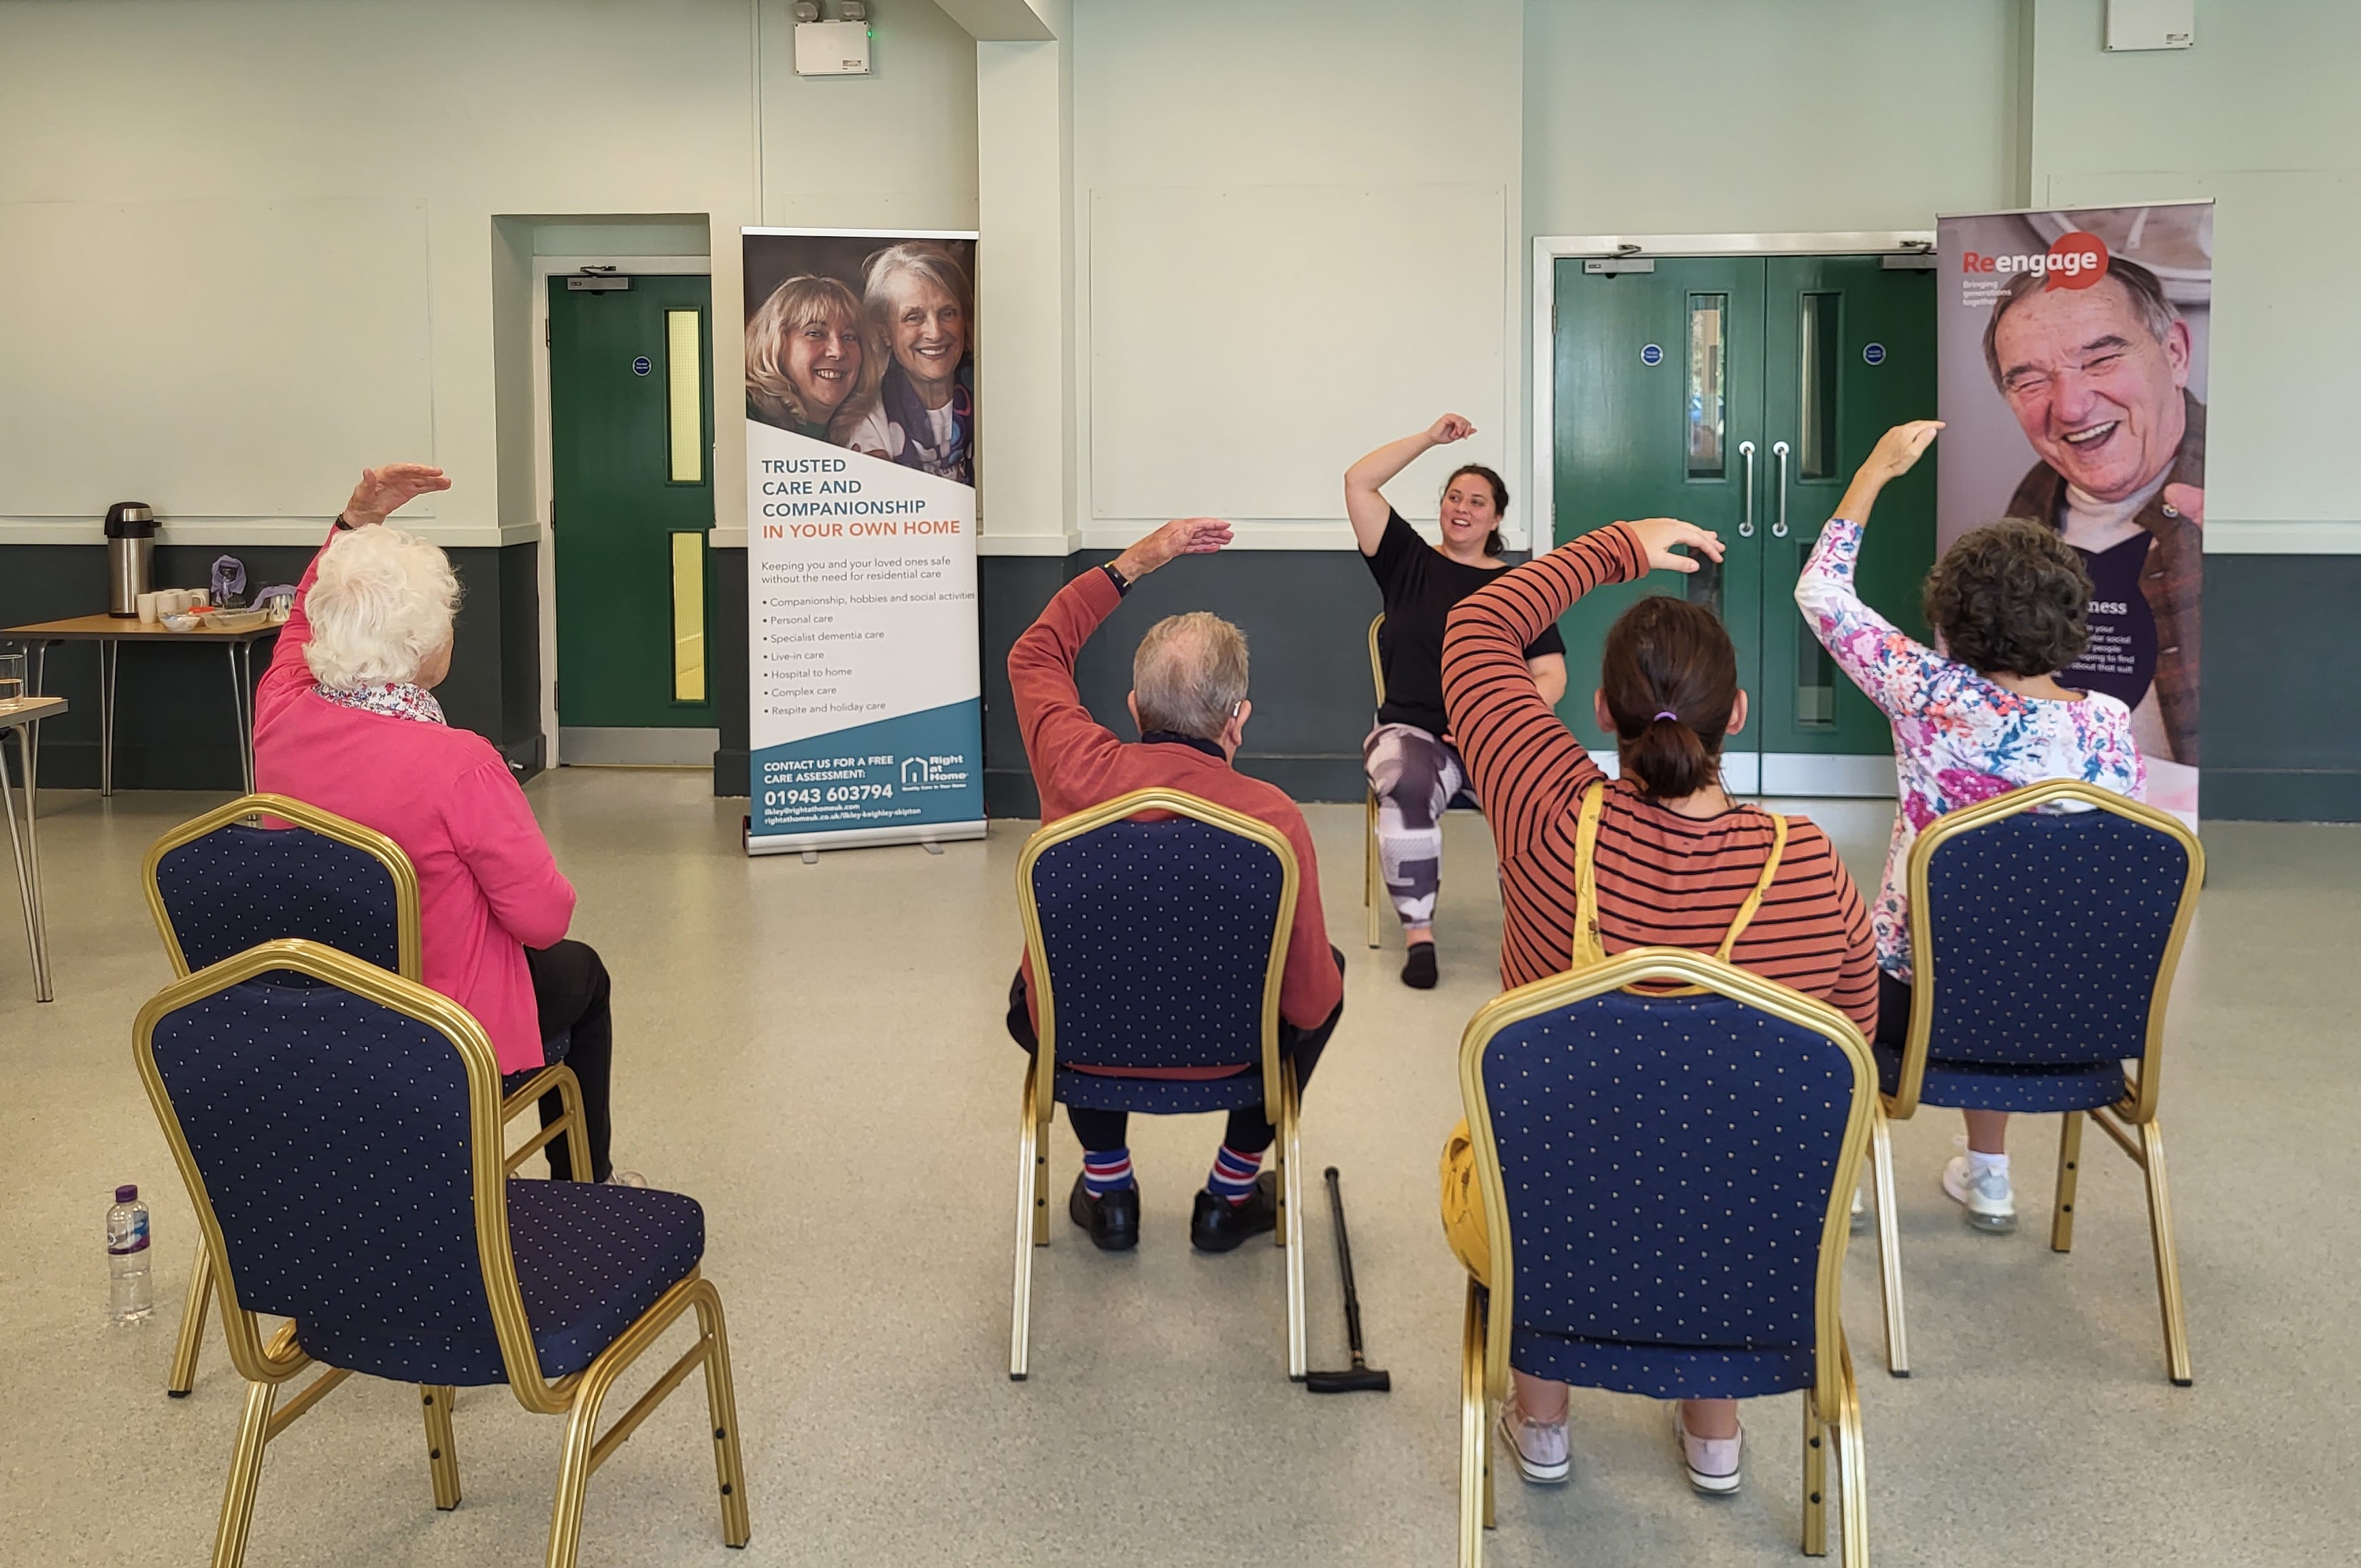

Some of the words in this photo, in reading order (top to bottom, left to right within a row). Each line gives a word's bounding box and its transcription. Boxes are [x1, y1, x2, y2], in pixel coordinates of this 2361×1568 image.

[1962, 251, 2098, 278] Reengage
[761, 458, 846, 473] TRUSTED
[763, 481, 813, 495] CARE
[820, 480, 861, 494] AND
[763, 500, 926, 517] COMPANIONSHIP
[763, 525, 783, 538] IN
[790, 523, 843, 537] YOUR
[850, 522, 897, 536] OWN
[904, 521, 960, 534] HOME
[762, 561, 804, 572] Keeping
[807, 563, 825, 571] you
[828, 560, 847, 569] and
[850, 560, 872, 569] your
[875, 558, 902, 567] loved
[931, 556, 951, 565] safe
[761, 574, 799, 584] without
[803, 573, 818, 582] the
[822, 572, 848, 582] need
[850, 572, 864, 580] for
[867, 570, 918, 580] residential
[770, 597, 848, 607] Companionship,
[850, 594, 887, 603] hobbies
[890, 593, 907, 602] and
[910, 593, 936, 601] social
[939, 591, 975, 601] activities
[2087, 601, 2127, 615] ness
[771, 615, 811, 624] Personal
[771, 633, 815, 644] Specialist
[818, 631, 863, 640] dementia
[771, 652, 801, 661] Live-in
[772, 669, 810, 680] Hospital
[814, 669, 823, 677] to
[826, 667, 852, 676] home
[772, 687, 814, 699] Complex
[772, 705, 807, 715] Respite
[809, 703, 827, 713] and
[830, 702, 863, 713] holiday
[867, 702, 886, 710] care
[764, 761, 815, 772] CONTACT
[818, 759, 831, 769] US
[833, 758, 854, 768] FOR
[857, 757, 866, 766] A
[868, 756, 894, 765] FREE
[930, 755, 963, 765] Right
[765, 773, 792, 784] CARE
[930, 772, 966, 781] Home
[765, 788, 821, 806] 01943
[826, 784, 893, 801] 603794
